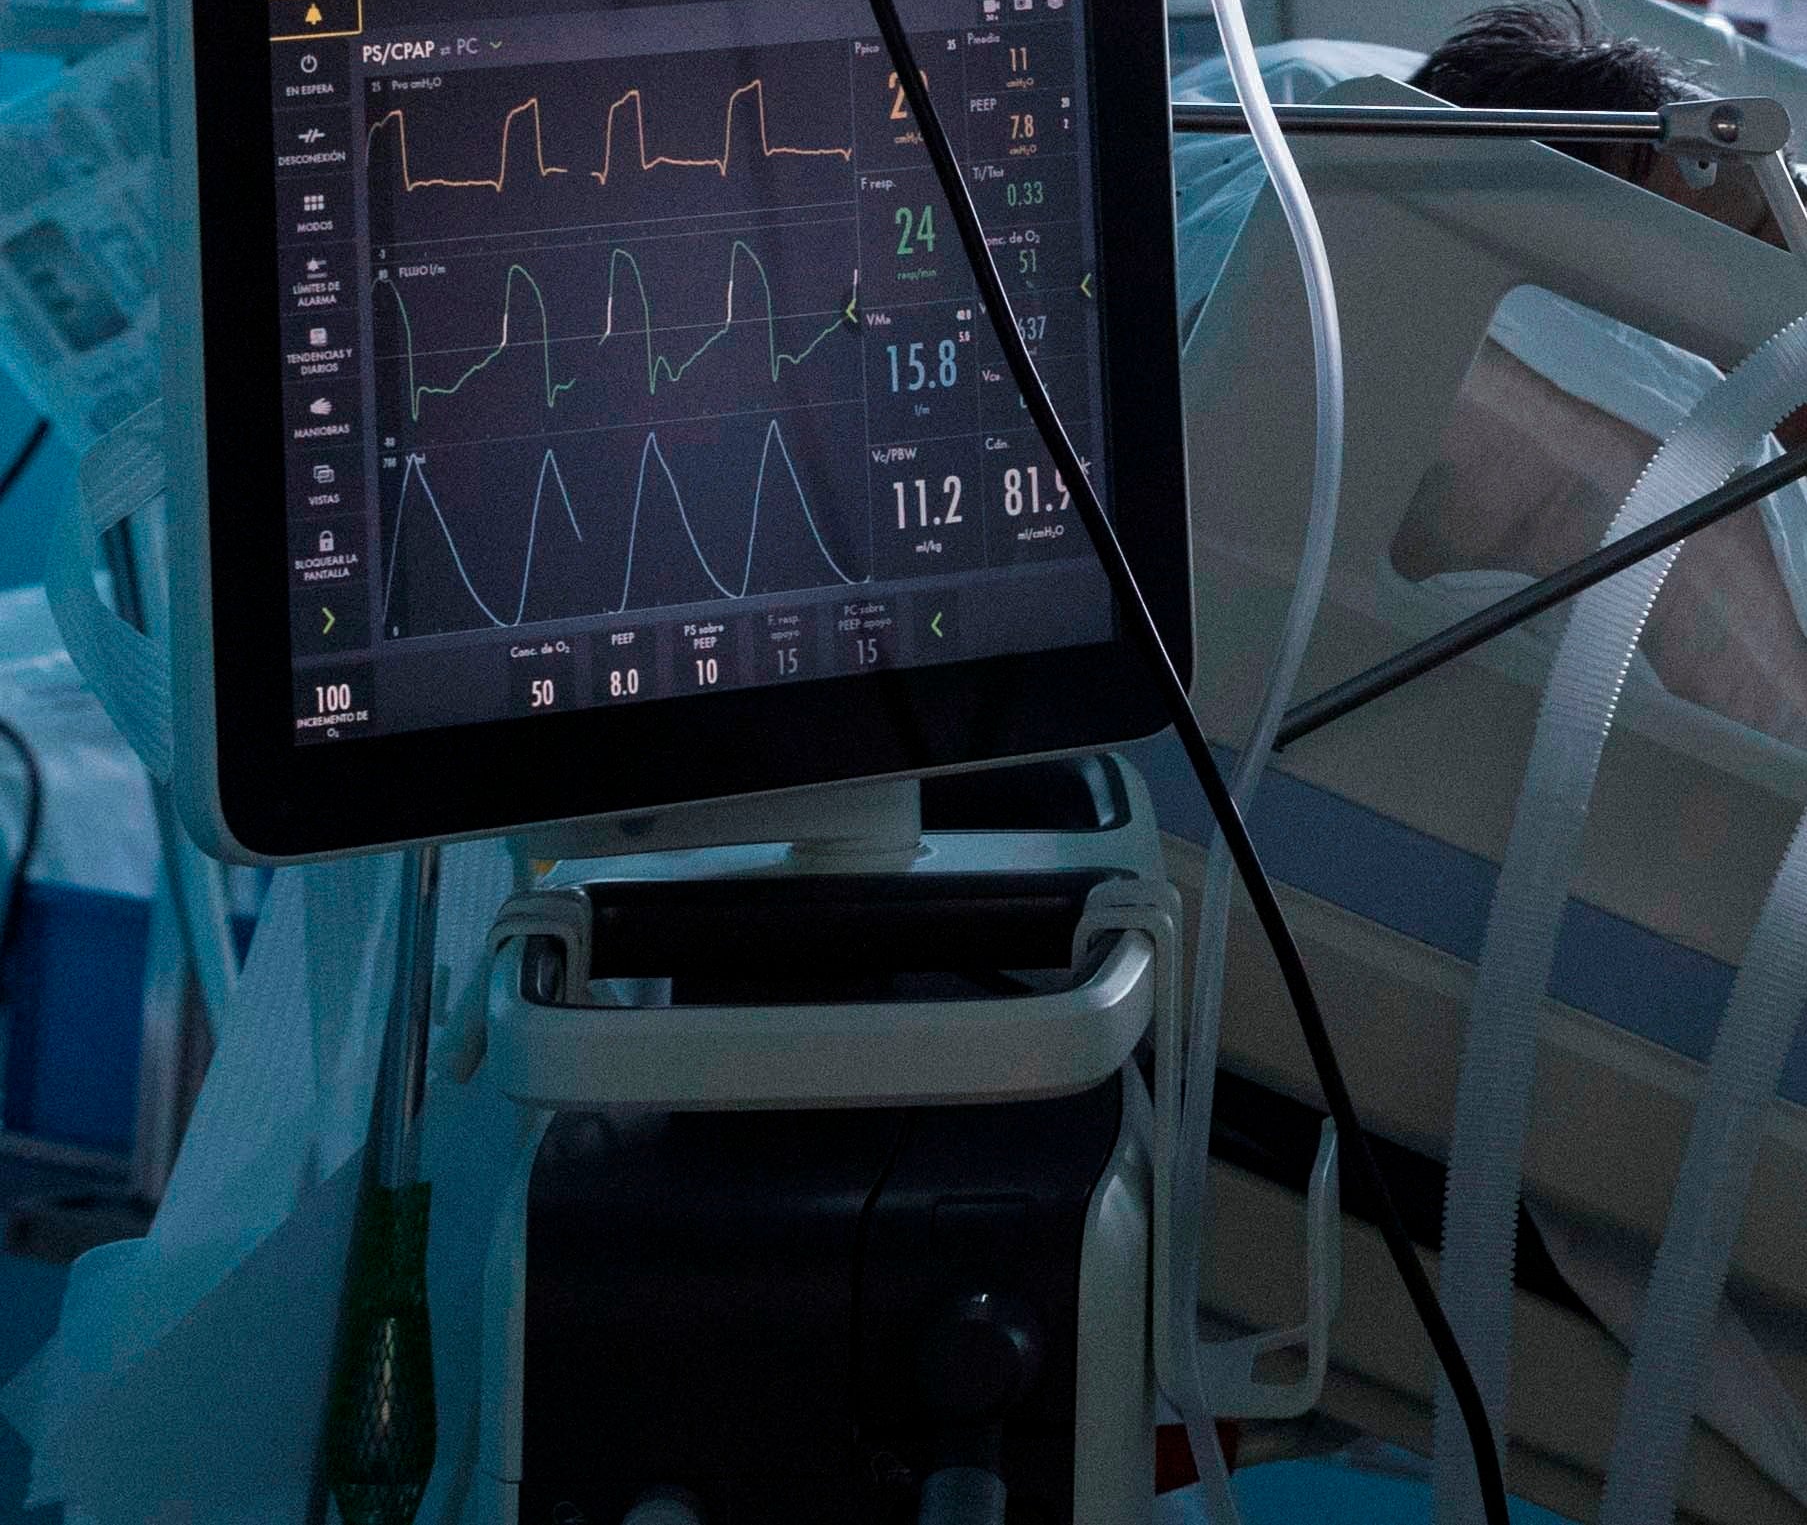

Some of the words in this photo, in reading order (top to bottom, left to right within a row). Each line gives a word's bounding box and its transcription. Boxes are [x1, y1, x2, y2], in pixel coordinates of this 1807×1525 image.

[362, 40, 436, 66] PS/CPAP
[456, 37, 479, 55] PC
[855, 41, 880, 55] Ppico
[1009, 46, 1028, 72] 11
[301, 83, 335, 96] ESPERA
[970, 97, 998, 113] PEEP
[1010, 114, 1034, 140] 7.8
[277, 149, 346, 166] DESCONEXIÓN
[1006, 181, 1045, 207] 0.33
[296, 220, 334, 233] MODOS
[895, 204, 936, 256] 24
[986, 234, 1007, 246] onc.
[1009, 231, 1023, 245] de
[1019, 248, 1037, 274] 51
[292, 280, 326, 295] LÍMITES
[327, 280, 341, 292] DE
[297, 294, 337, 307] ALARMA
[286, 351, 342, 365] TENDENCIAS
[343, 348, 353, 359] Y
[300, 362, 338, 376] DIARIOS
[886, 339, 958, 393] 15.8
[293, 424, 350, 439] MANIOBRAS
[872, 448, 917, 464] Vc/PBW
[308, 493, 341, 506] VISTAS
[892, 475, 963, 530] 11.2
[294, 555, 345, 570] BLOQUEAR
[345, 554, 359, 565] LA
[303, 568, 351, 581] PANTALLA
[611, 631, 636, 647] PEEP
[683, 623, 697, 638] PS
[540, 643, 554, 655] de
[693, 635, 718, 652] PEEP
[855, 638, 878, 665] 15
[776, 648, 799, 676] 15
[695, 657, 719, 686] 10
[610, 669, 639, 697] 8.0
[314, 683, 352, 714] 100
[531, 679, 555, 708] 50
[296, 713, 355, 729] INCREMENTO
[356, 710, 369, 722] DE
